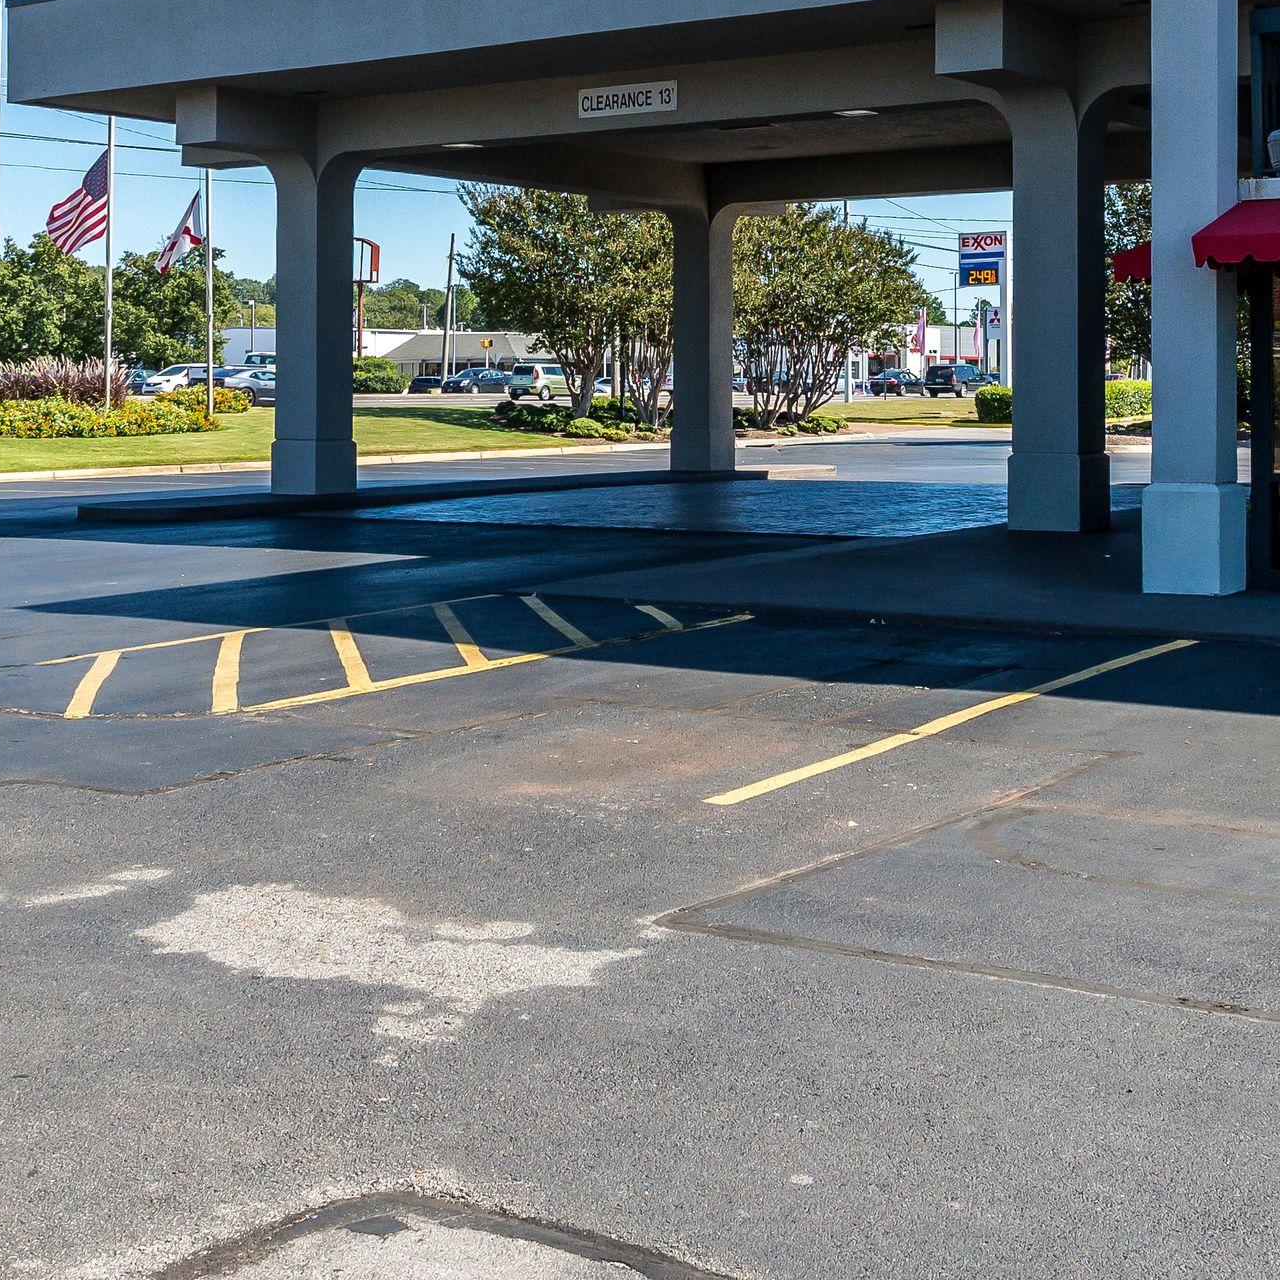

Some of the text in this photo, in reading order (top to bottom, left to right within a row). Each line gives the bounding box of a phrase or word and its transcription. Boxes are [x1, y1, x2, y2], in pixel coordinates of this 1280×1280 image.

[581, 87, 675, 113] CLEARANCE 13'
[961, 234, 1003, 251] EXXON
